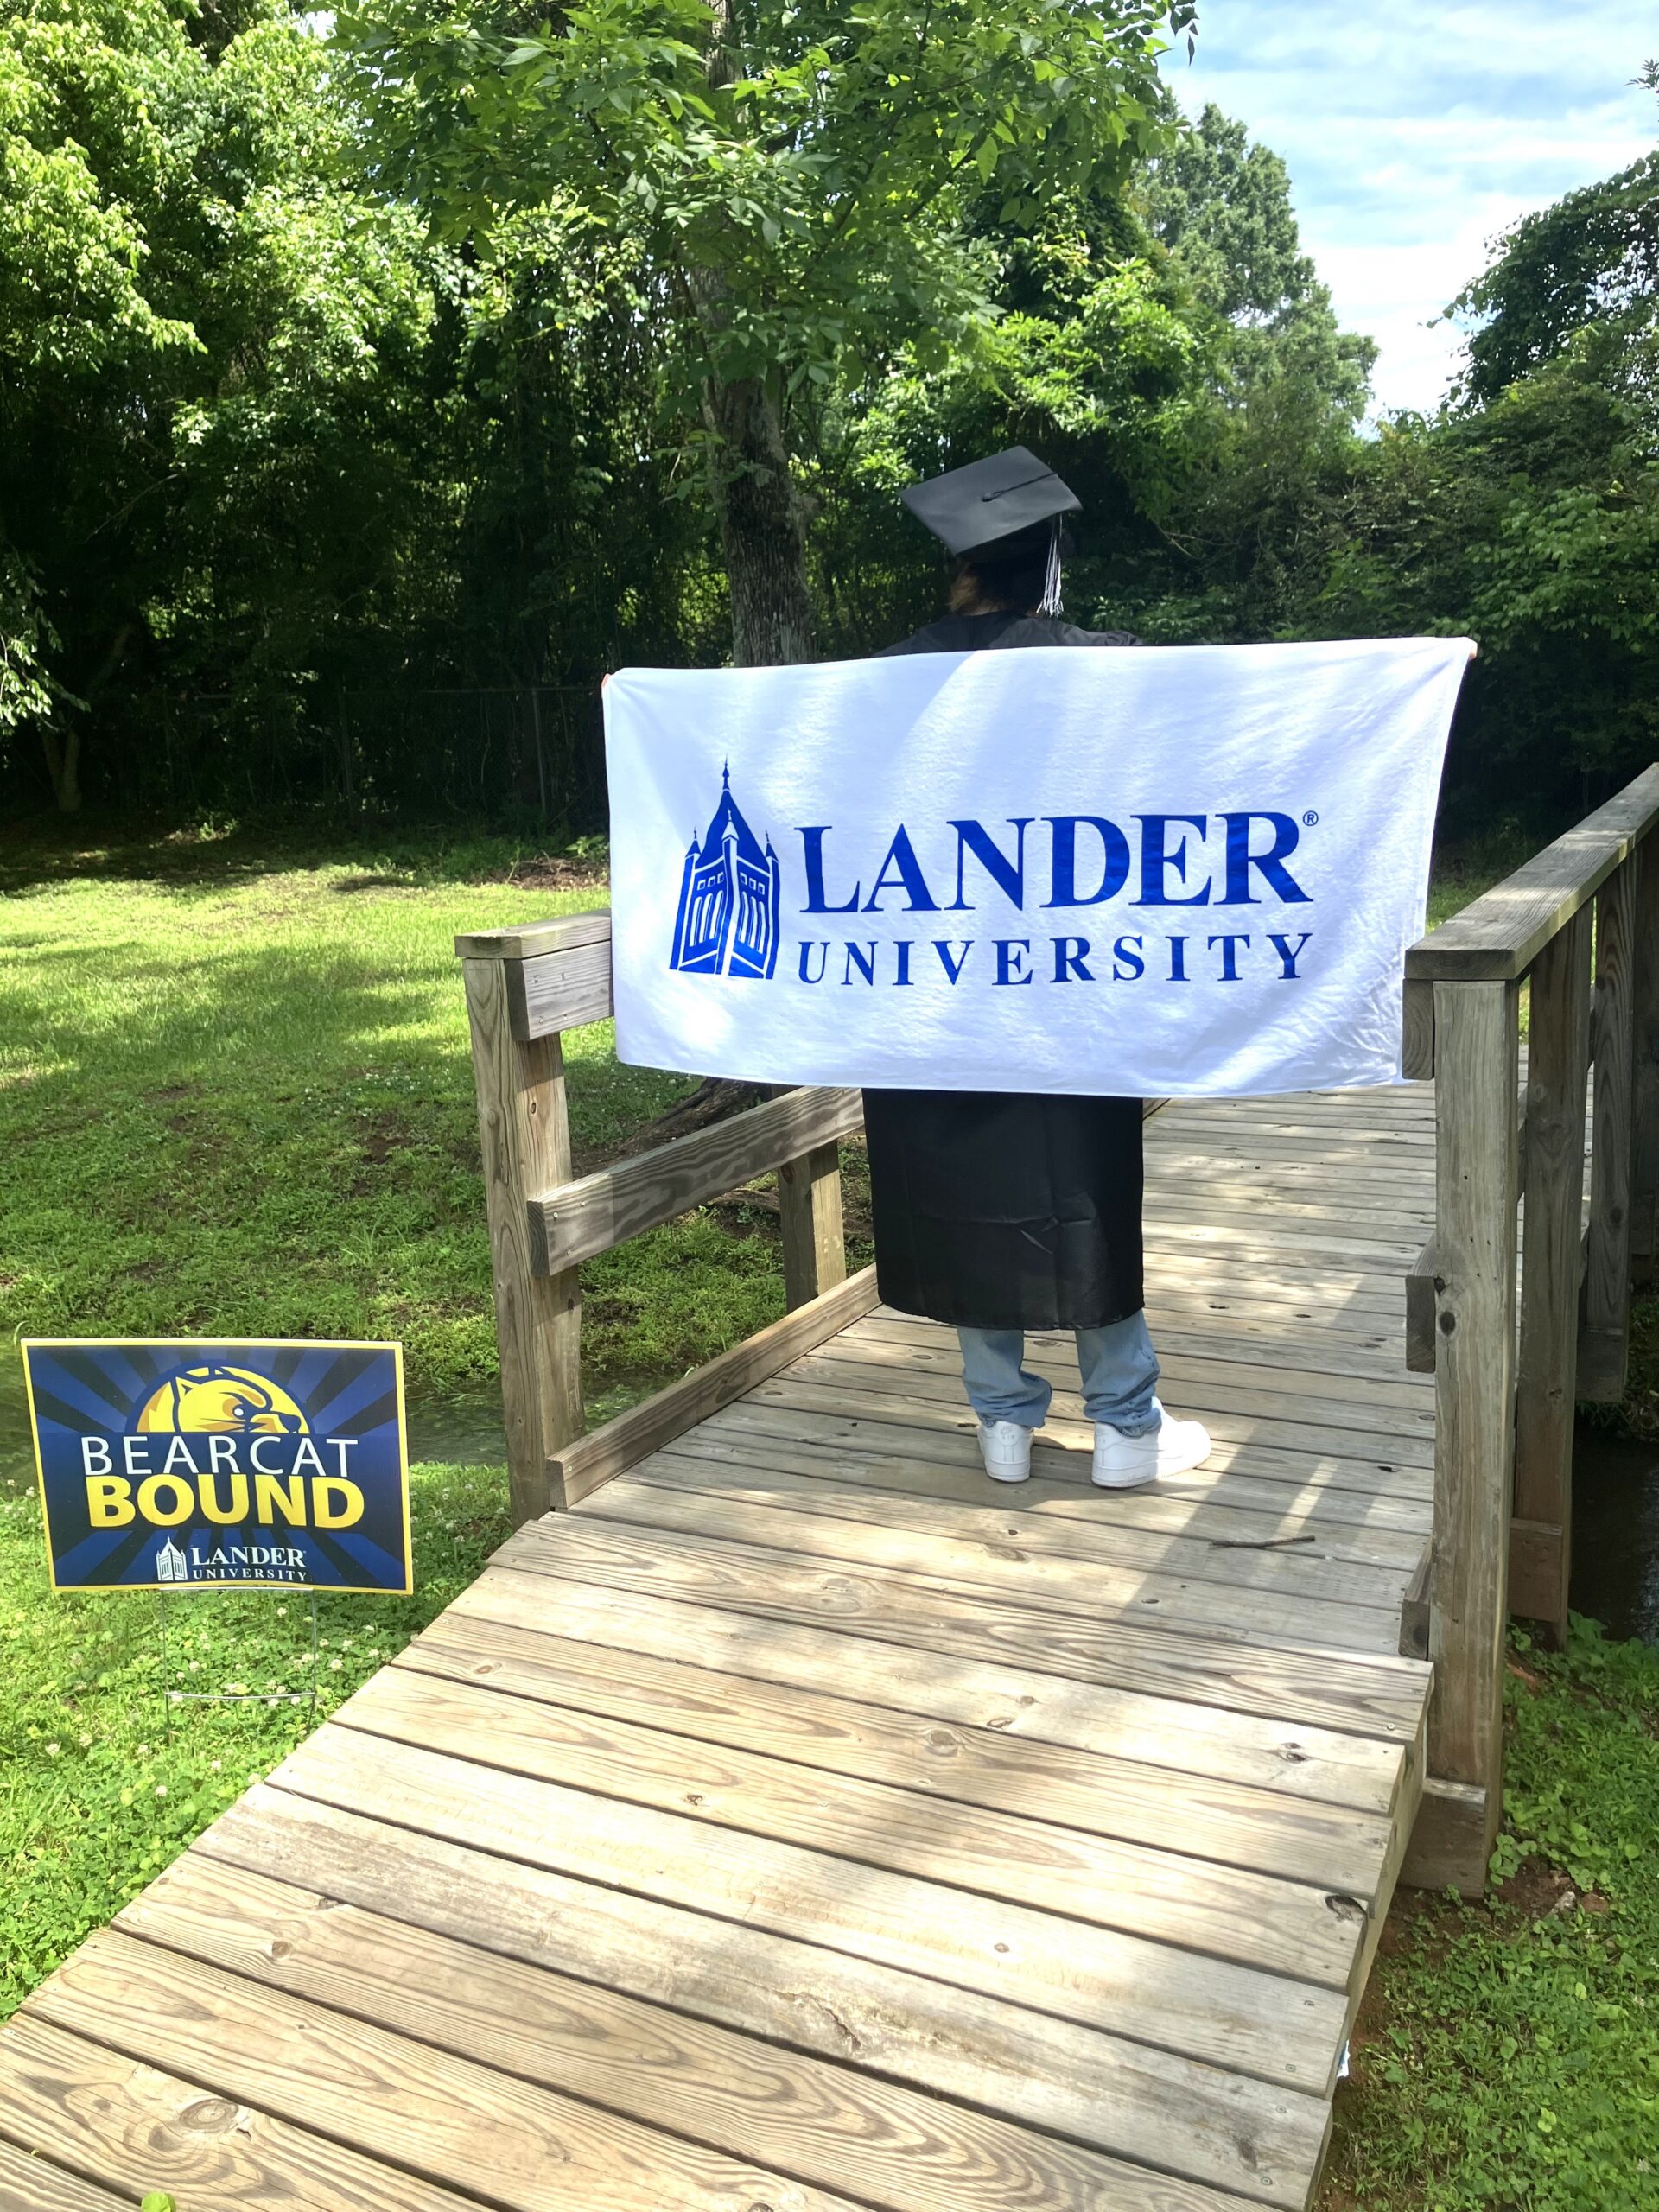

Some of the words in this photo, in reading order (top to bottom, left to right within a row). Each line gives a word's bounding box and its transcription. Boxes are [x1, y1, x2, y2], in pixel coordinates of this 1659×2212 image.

[798, 932, 1313, 986] UNIVERSITY
[81, 1435, 358, 1477] BEARCAT
[86, 1473, 365, 1528] BOUND
[191, 1546, 306, 1567] LANDER
[193, 1568, 308, 1581] UNIVERSITY
